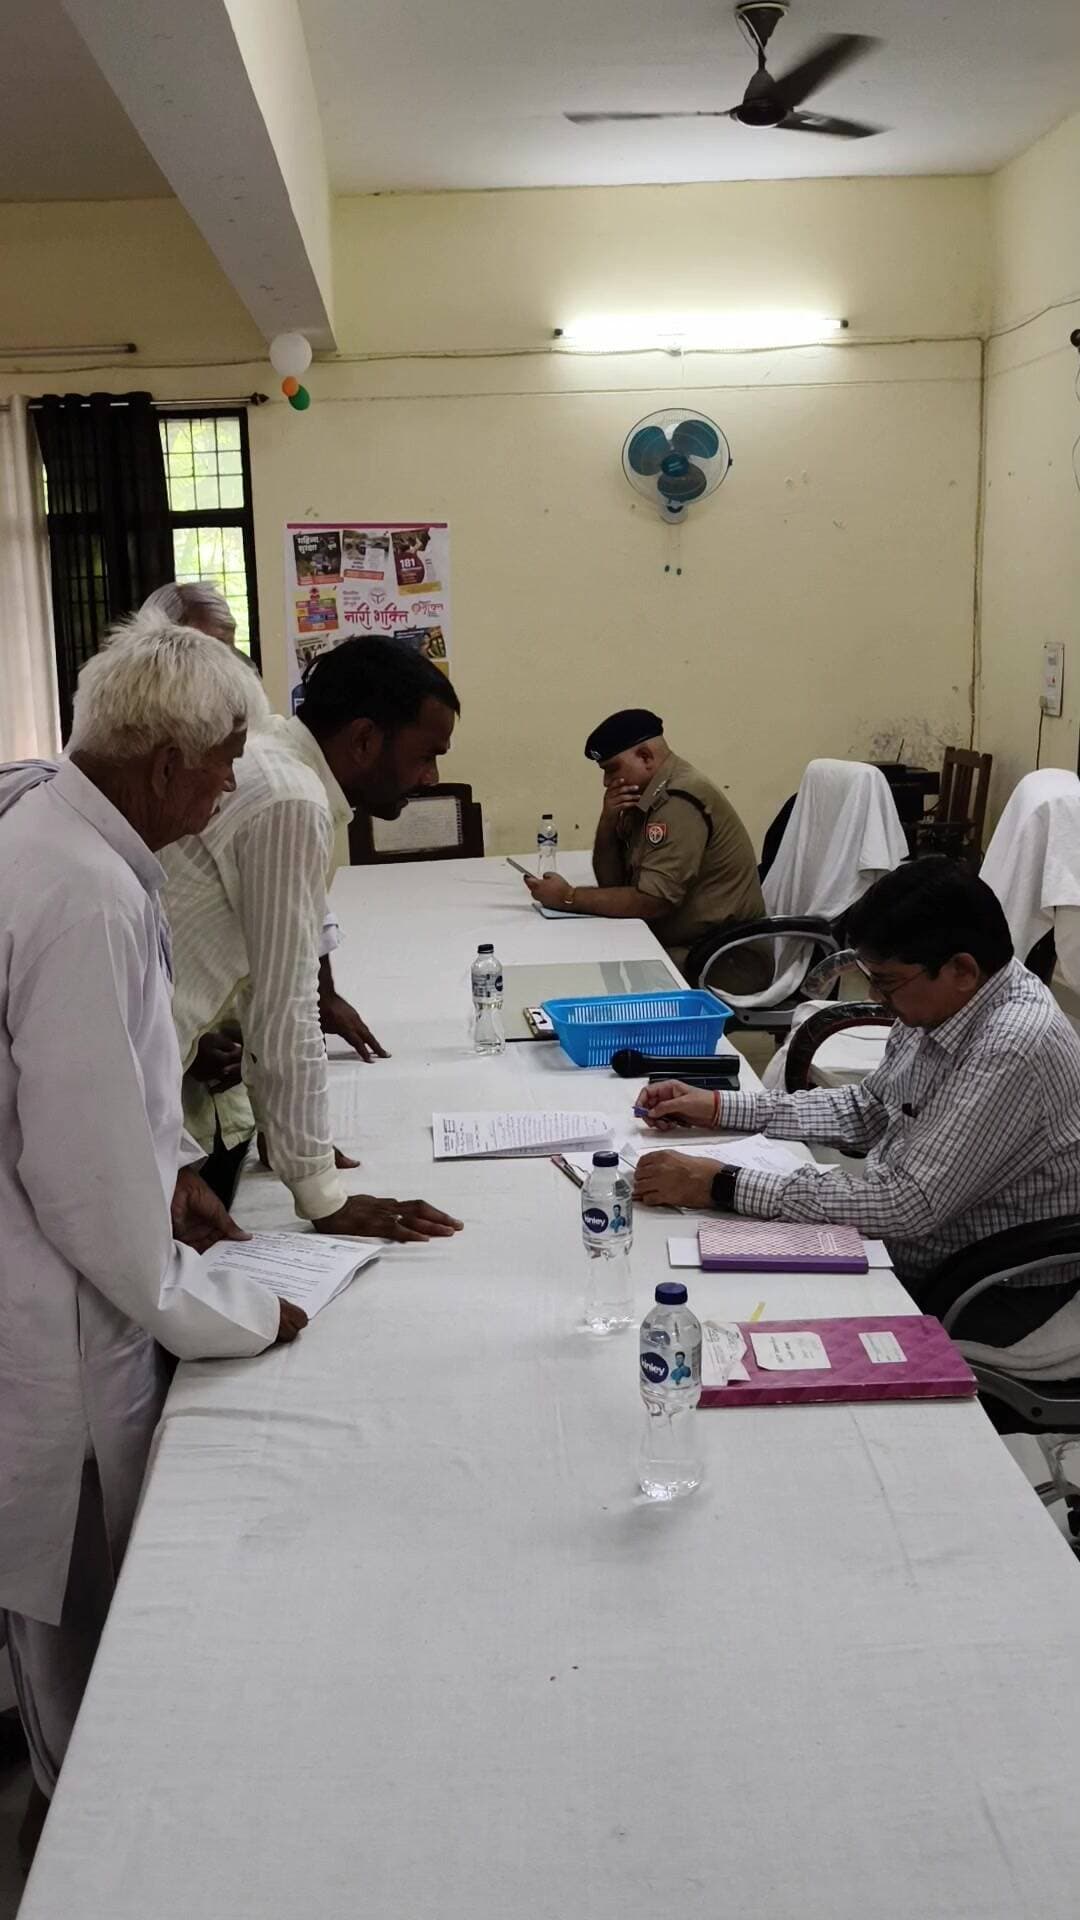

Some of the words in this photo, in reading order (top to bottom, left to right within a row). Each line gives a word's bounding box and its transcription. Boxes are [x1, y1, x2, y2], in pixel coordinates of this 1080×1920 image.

[400, 558, 416, 569] 181
[344, 602, 372, 630] नारी
[373, 602, 409, 630] शक्ति
